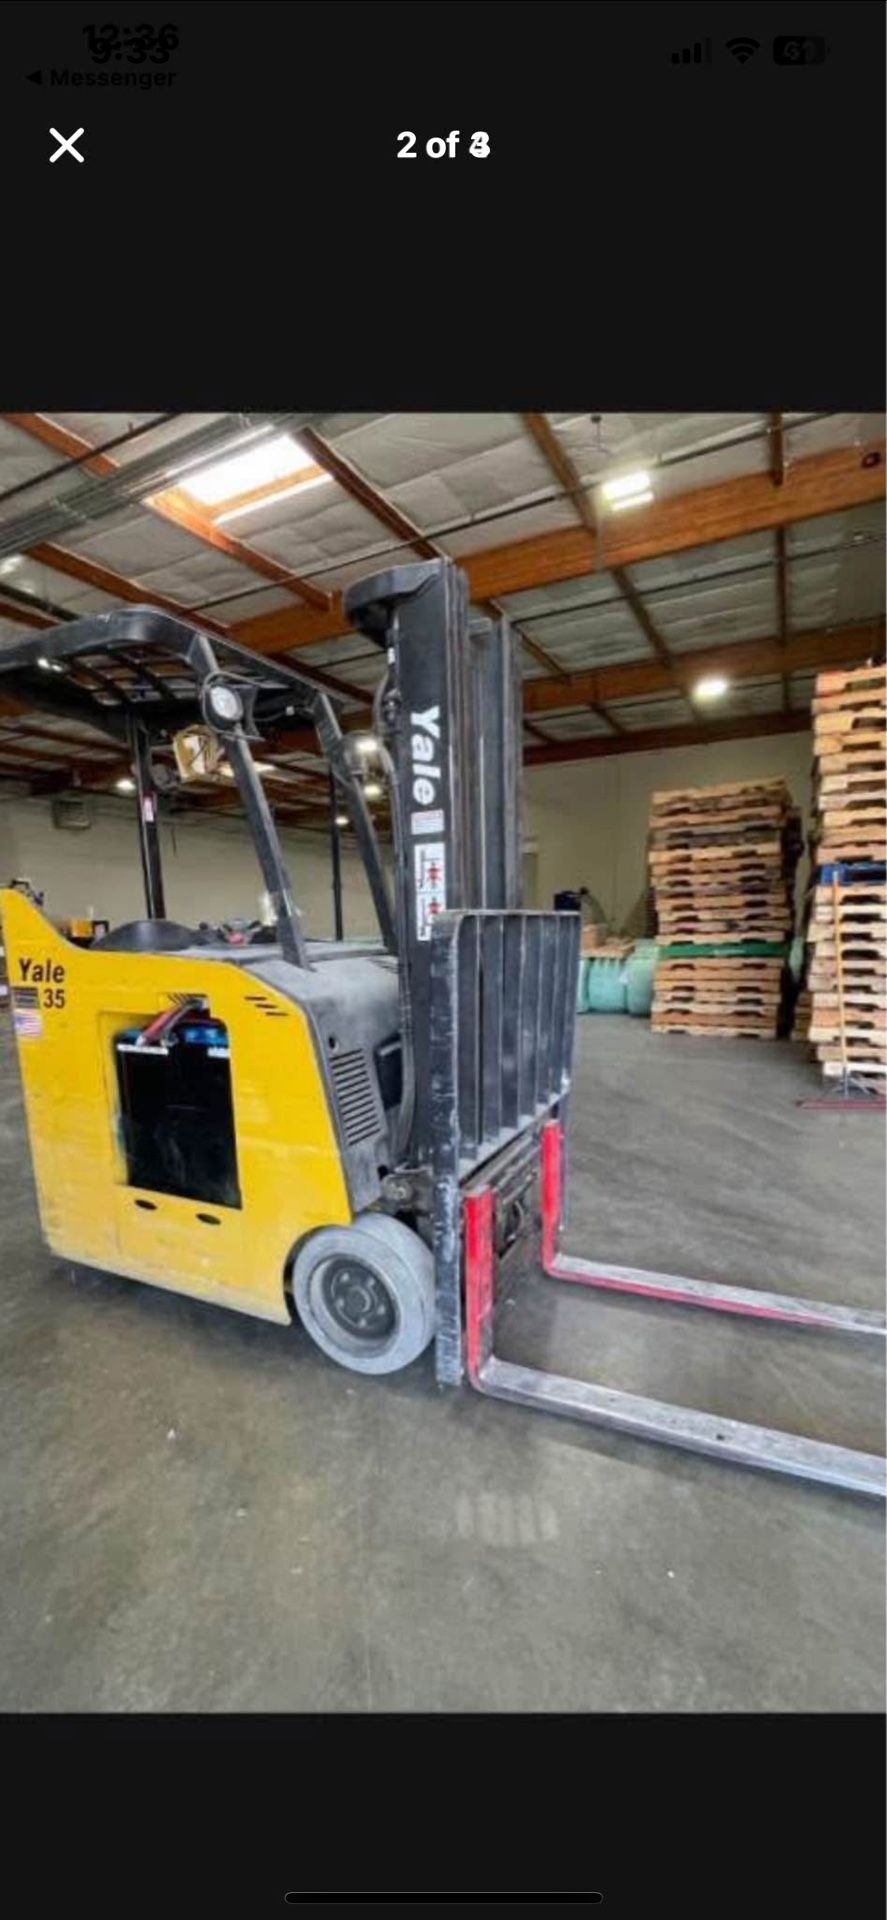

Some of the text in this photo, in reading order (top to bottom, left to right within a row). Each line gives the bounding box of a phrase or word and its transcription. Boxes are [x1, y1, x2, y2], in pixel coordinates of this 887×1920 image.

[411, 705, 442, 806] Yale
[18, 957, 65, 984] Yale
[43, 987, 66, 1009] 35
